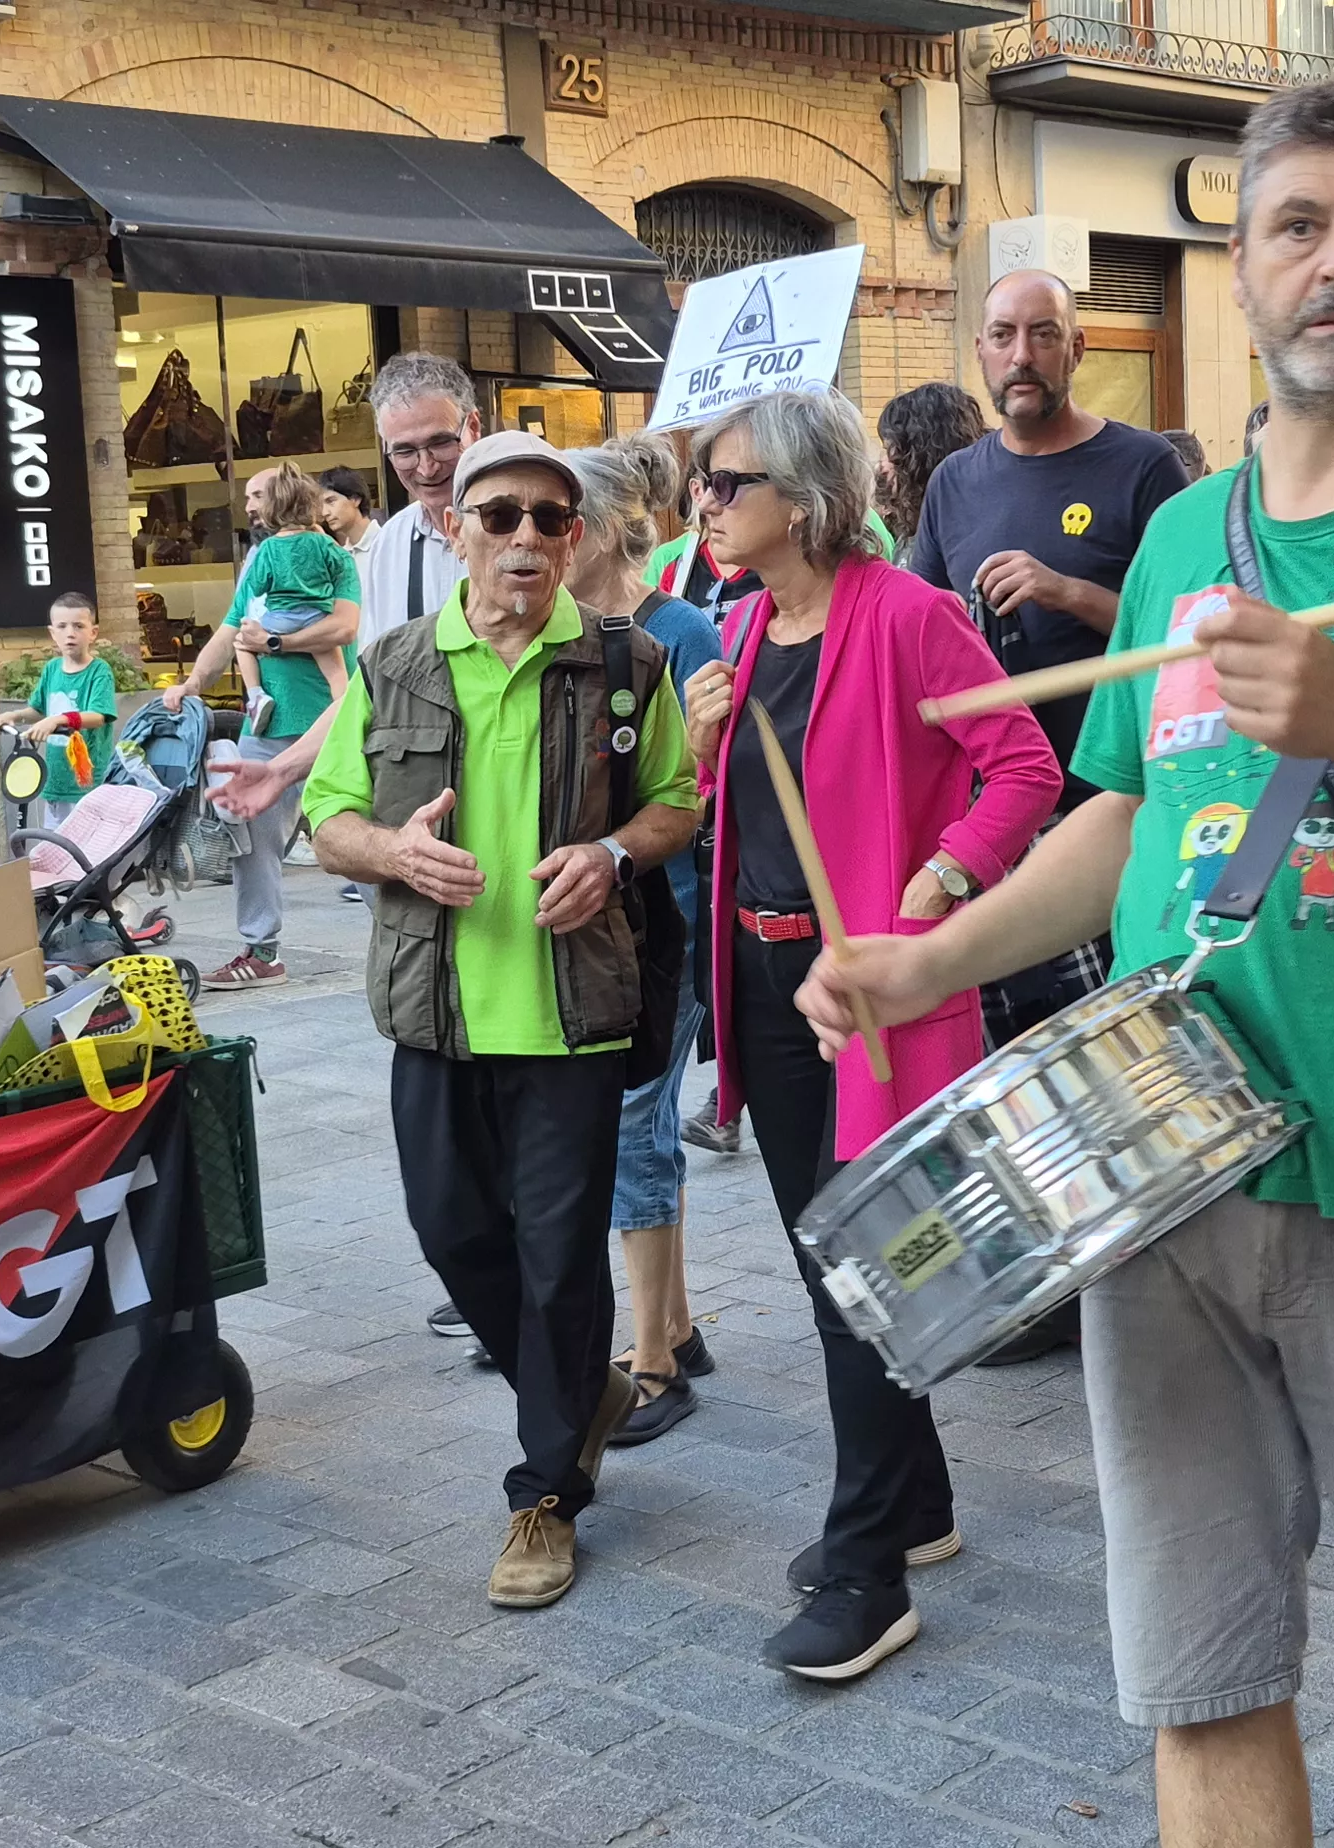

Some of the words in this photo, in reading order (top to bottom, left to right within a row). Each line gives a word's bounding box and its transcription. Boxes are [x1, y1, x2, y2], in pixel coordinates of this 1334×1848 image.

[561, 54, 604, 103] 25
[1200, 170, 1239, 194] MOL
[688, 363, 726, 396] BIG
[743, 348, 804, 380] POLO
[0, 314, 50, 498] MISAKO
[673, 401, 692, 418] IS
[698, 382, 764, 410] WATCHING
[774, 375, 803, 391] YOU
[1154, 711, 1224, 750] CGT
